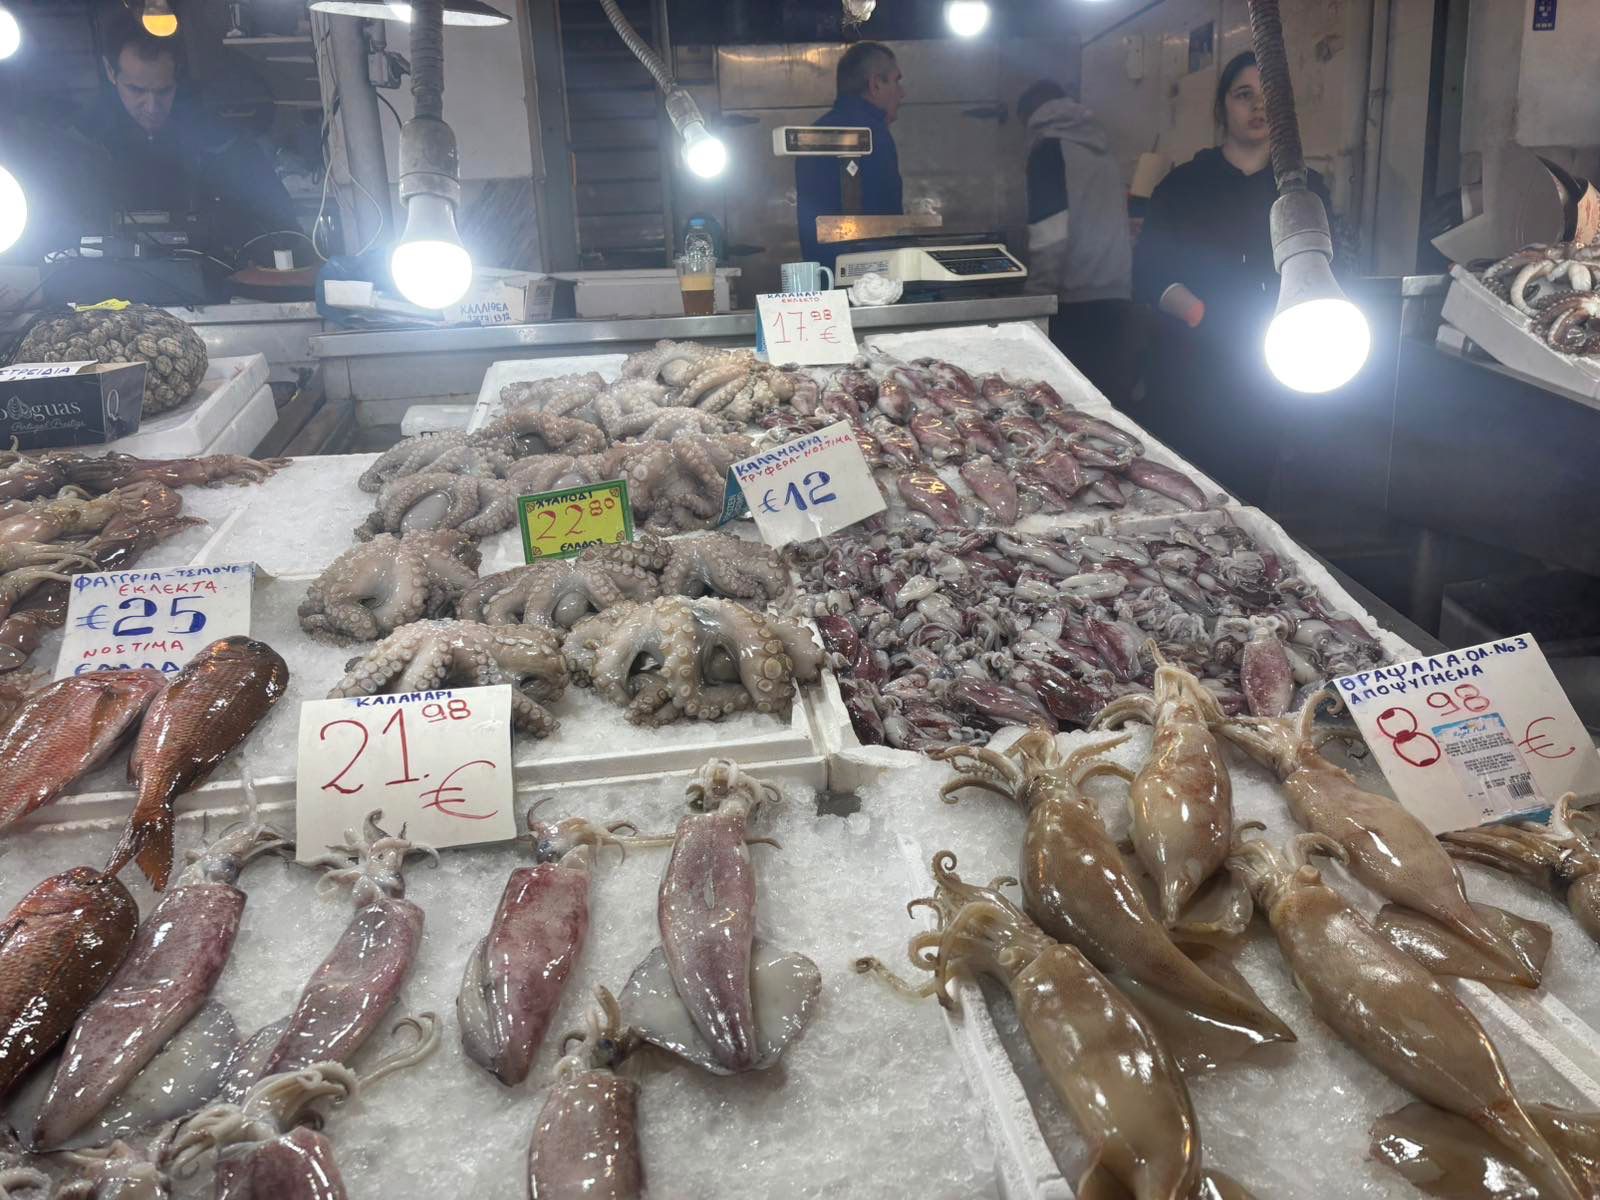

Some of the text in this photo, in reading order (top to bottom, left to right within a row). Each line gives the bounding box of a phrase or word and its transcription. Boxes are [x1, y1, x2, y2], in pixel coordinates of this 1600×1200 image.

[820, 325, 840, 343] €
[83, 640, 184, 659] ΝΟΣΤΙΜΑ
[356, 690, 452, 707] ΚΑΛΑΜΑΡΙ
[1350, 664, 1484, 705] ΑΠΟΨΥΓΜΕΝΑ
[1518, 717, 1576, 758] €
[419, 760, 499, 819] €
